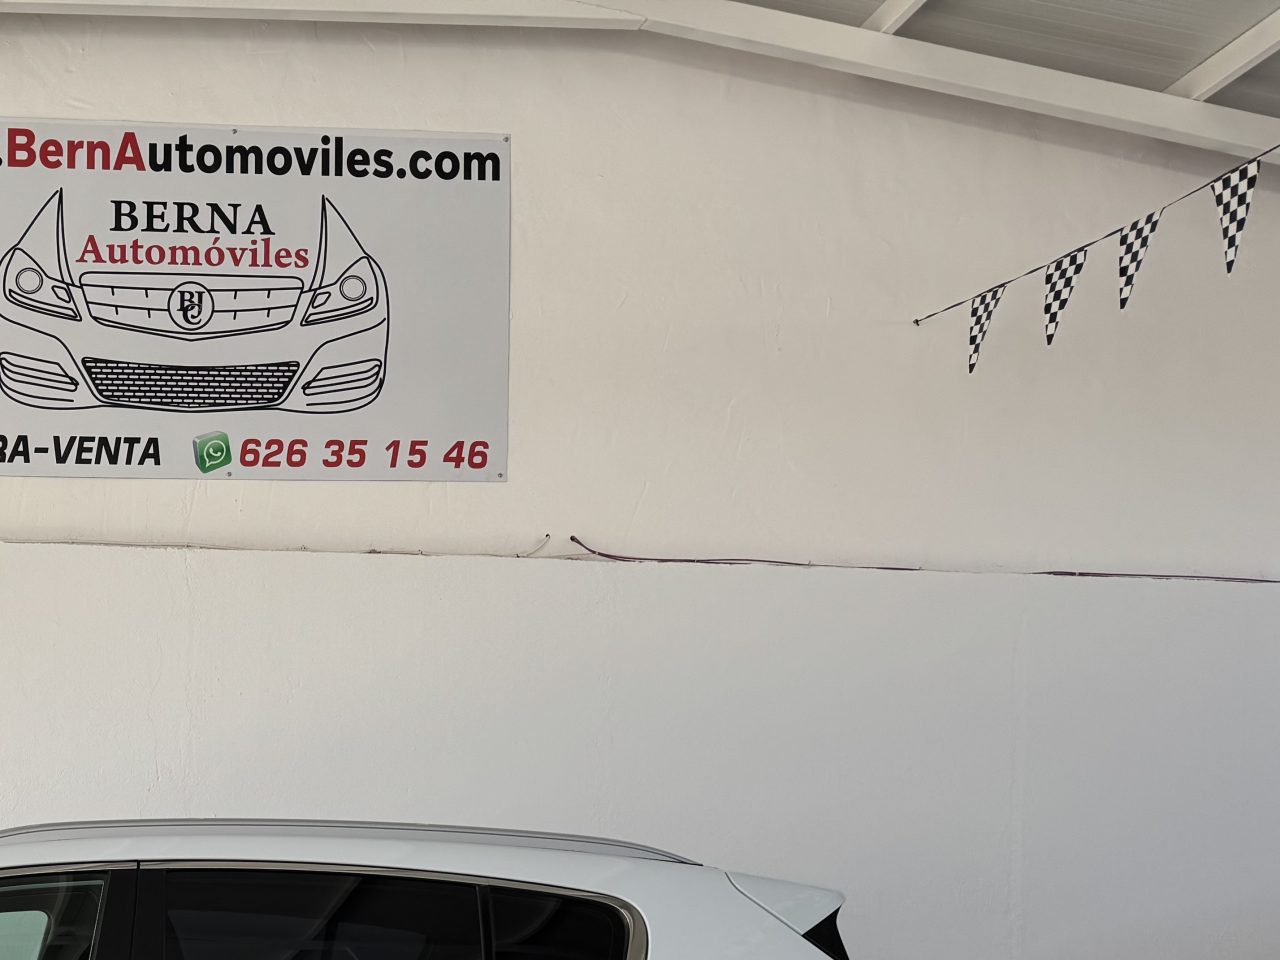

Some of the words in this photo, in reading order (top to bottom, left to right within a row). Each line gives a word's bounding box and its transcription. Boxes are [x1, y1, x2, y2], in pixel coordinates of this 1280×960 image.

[110, 199, 276, 236] BERNA
[76, 234, 310, 269] Automóviles
[239, 439, 309, 468] 626
[322, 439, 368, 469] 35
[385, 440, 429, 470] 15
[442, 441, 491, 470] 46
